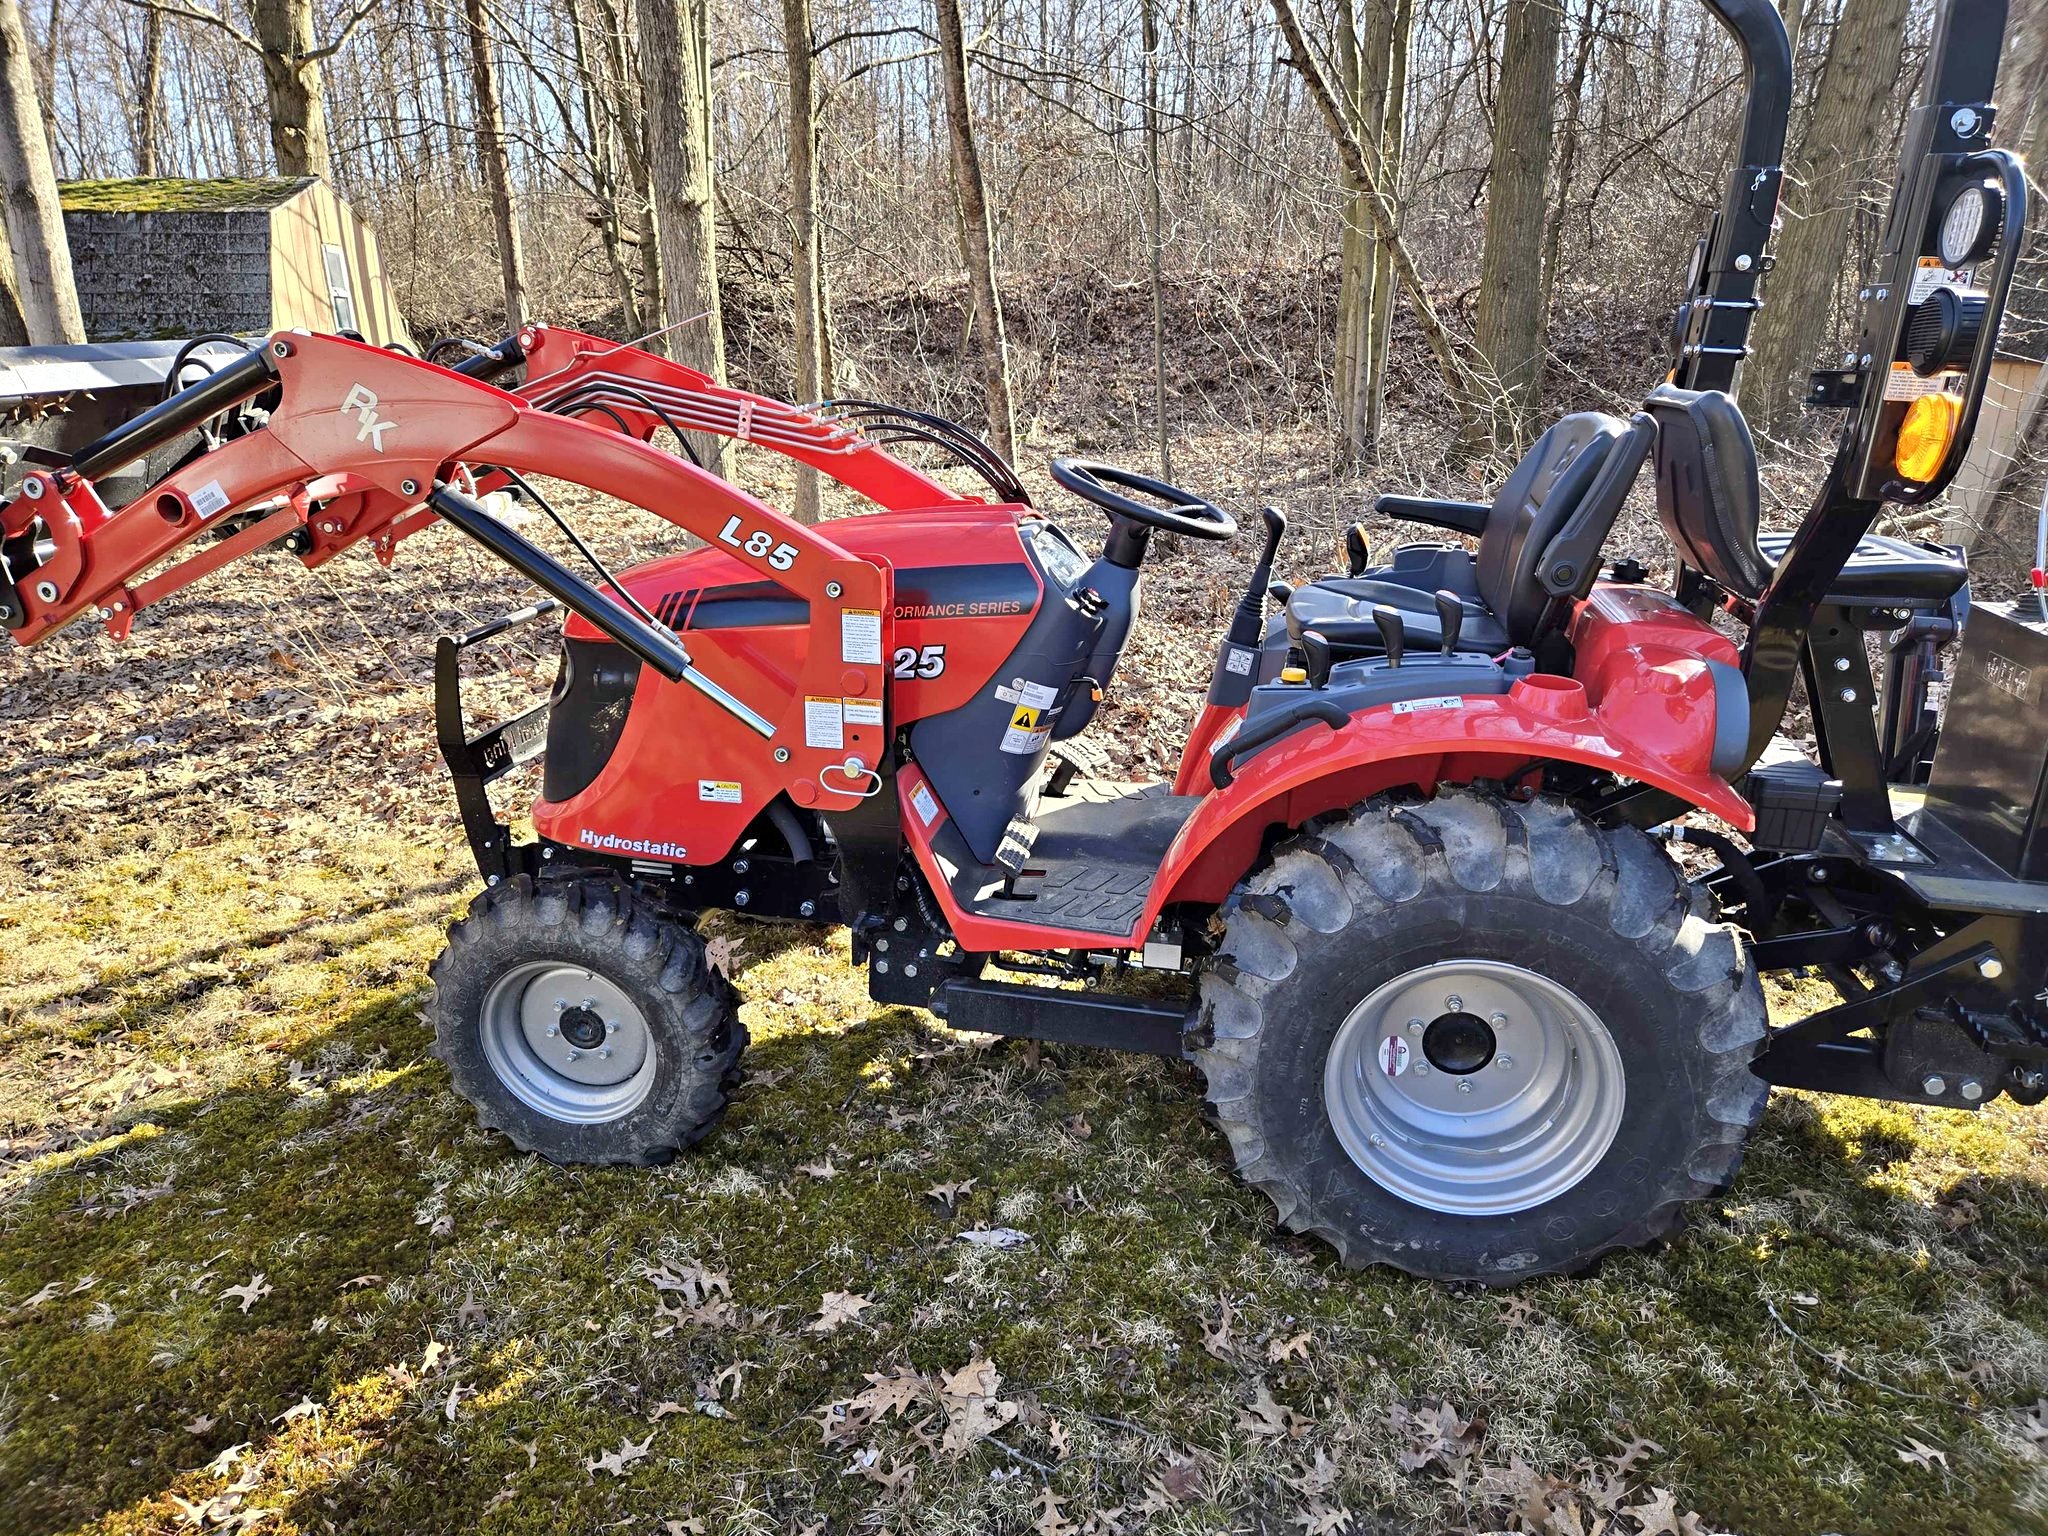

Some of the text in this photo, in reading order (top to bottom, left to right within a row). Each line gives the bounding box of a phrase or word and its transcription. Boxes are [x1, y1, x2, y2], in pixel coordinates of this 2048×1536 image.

[340, 381, 399, 454] RK
[717, 514, 800, 571] L85
[968, 600, 1021, 615] SERIES
[894, 644, 946, 680] 25
[580, 829, 687, 859] Hydrostatic
